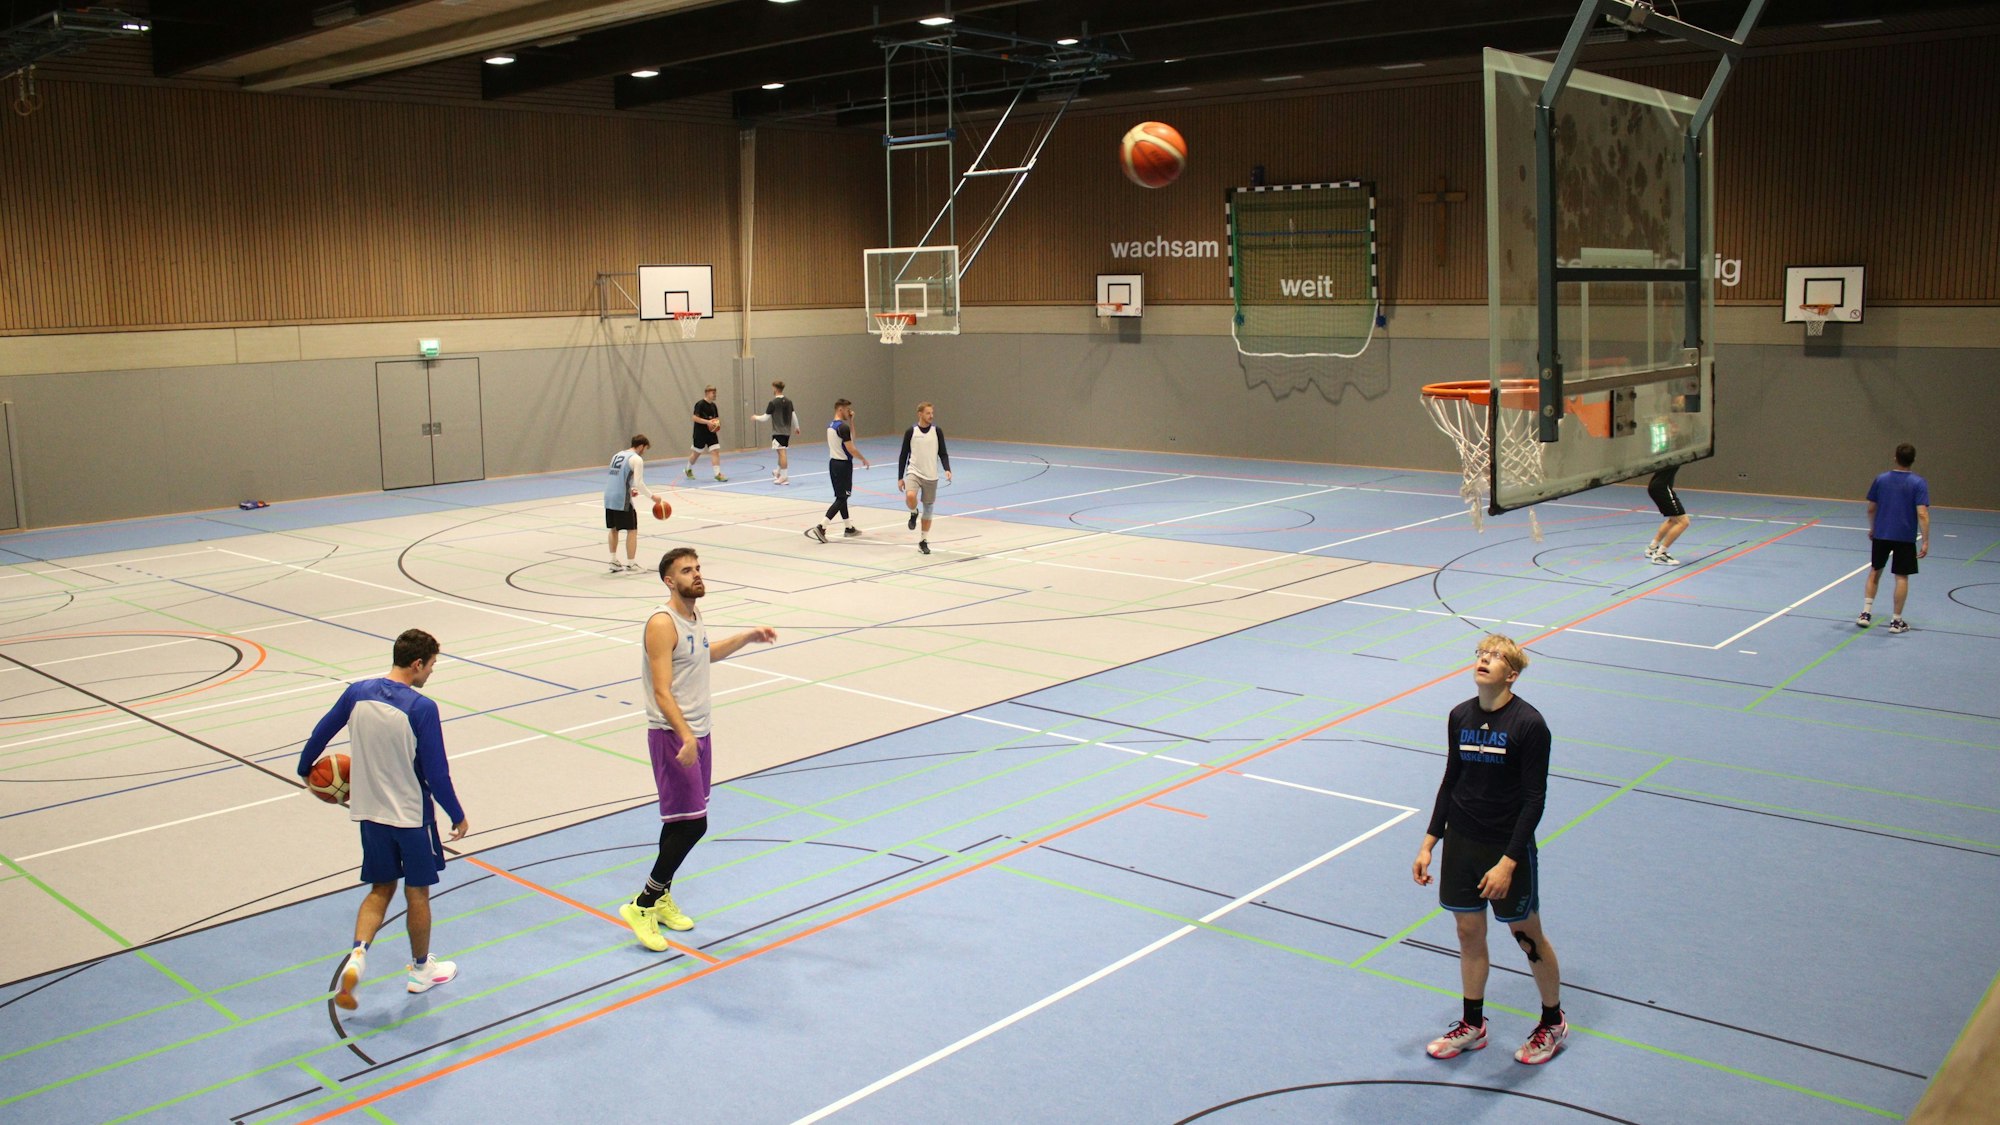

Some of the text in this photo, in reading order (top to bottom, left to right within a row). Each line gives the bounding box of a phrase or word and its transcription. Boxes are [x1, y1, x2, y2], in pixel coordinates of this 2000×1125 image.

[1110, 235, 1219, 258] wachsam
[1280, 275, 1333, 298] weit
[611, 455, 625, 469] 12
[686, 634, 695, 656] 7
[1460, 728, 1508, 747] DALLAS
